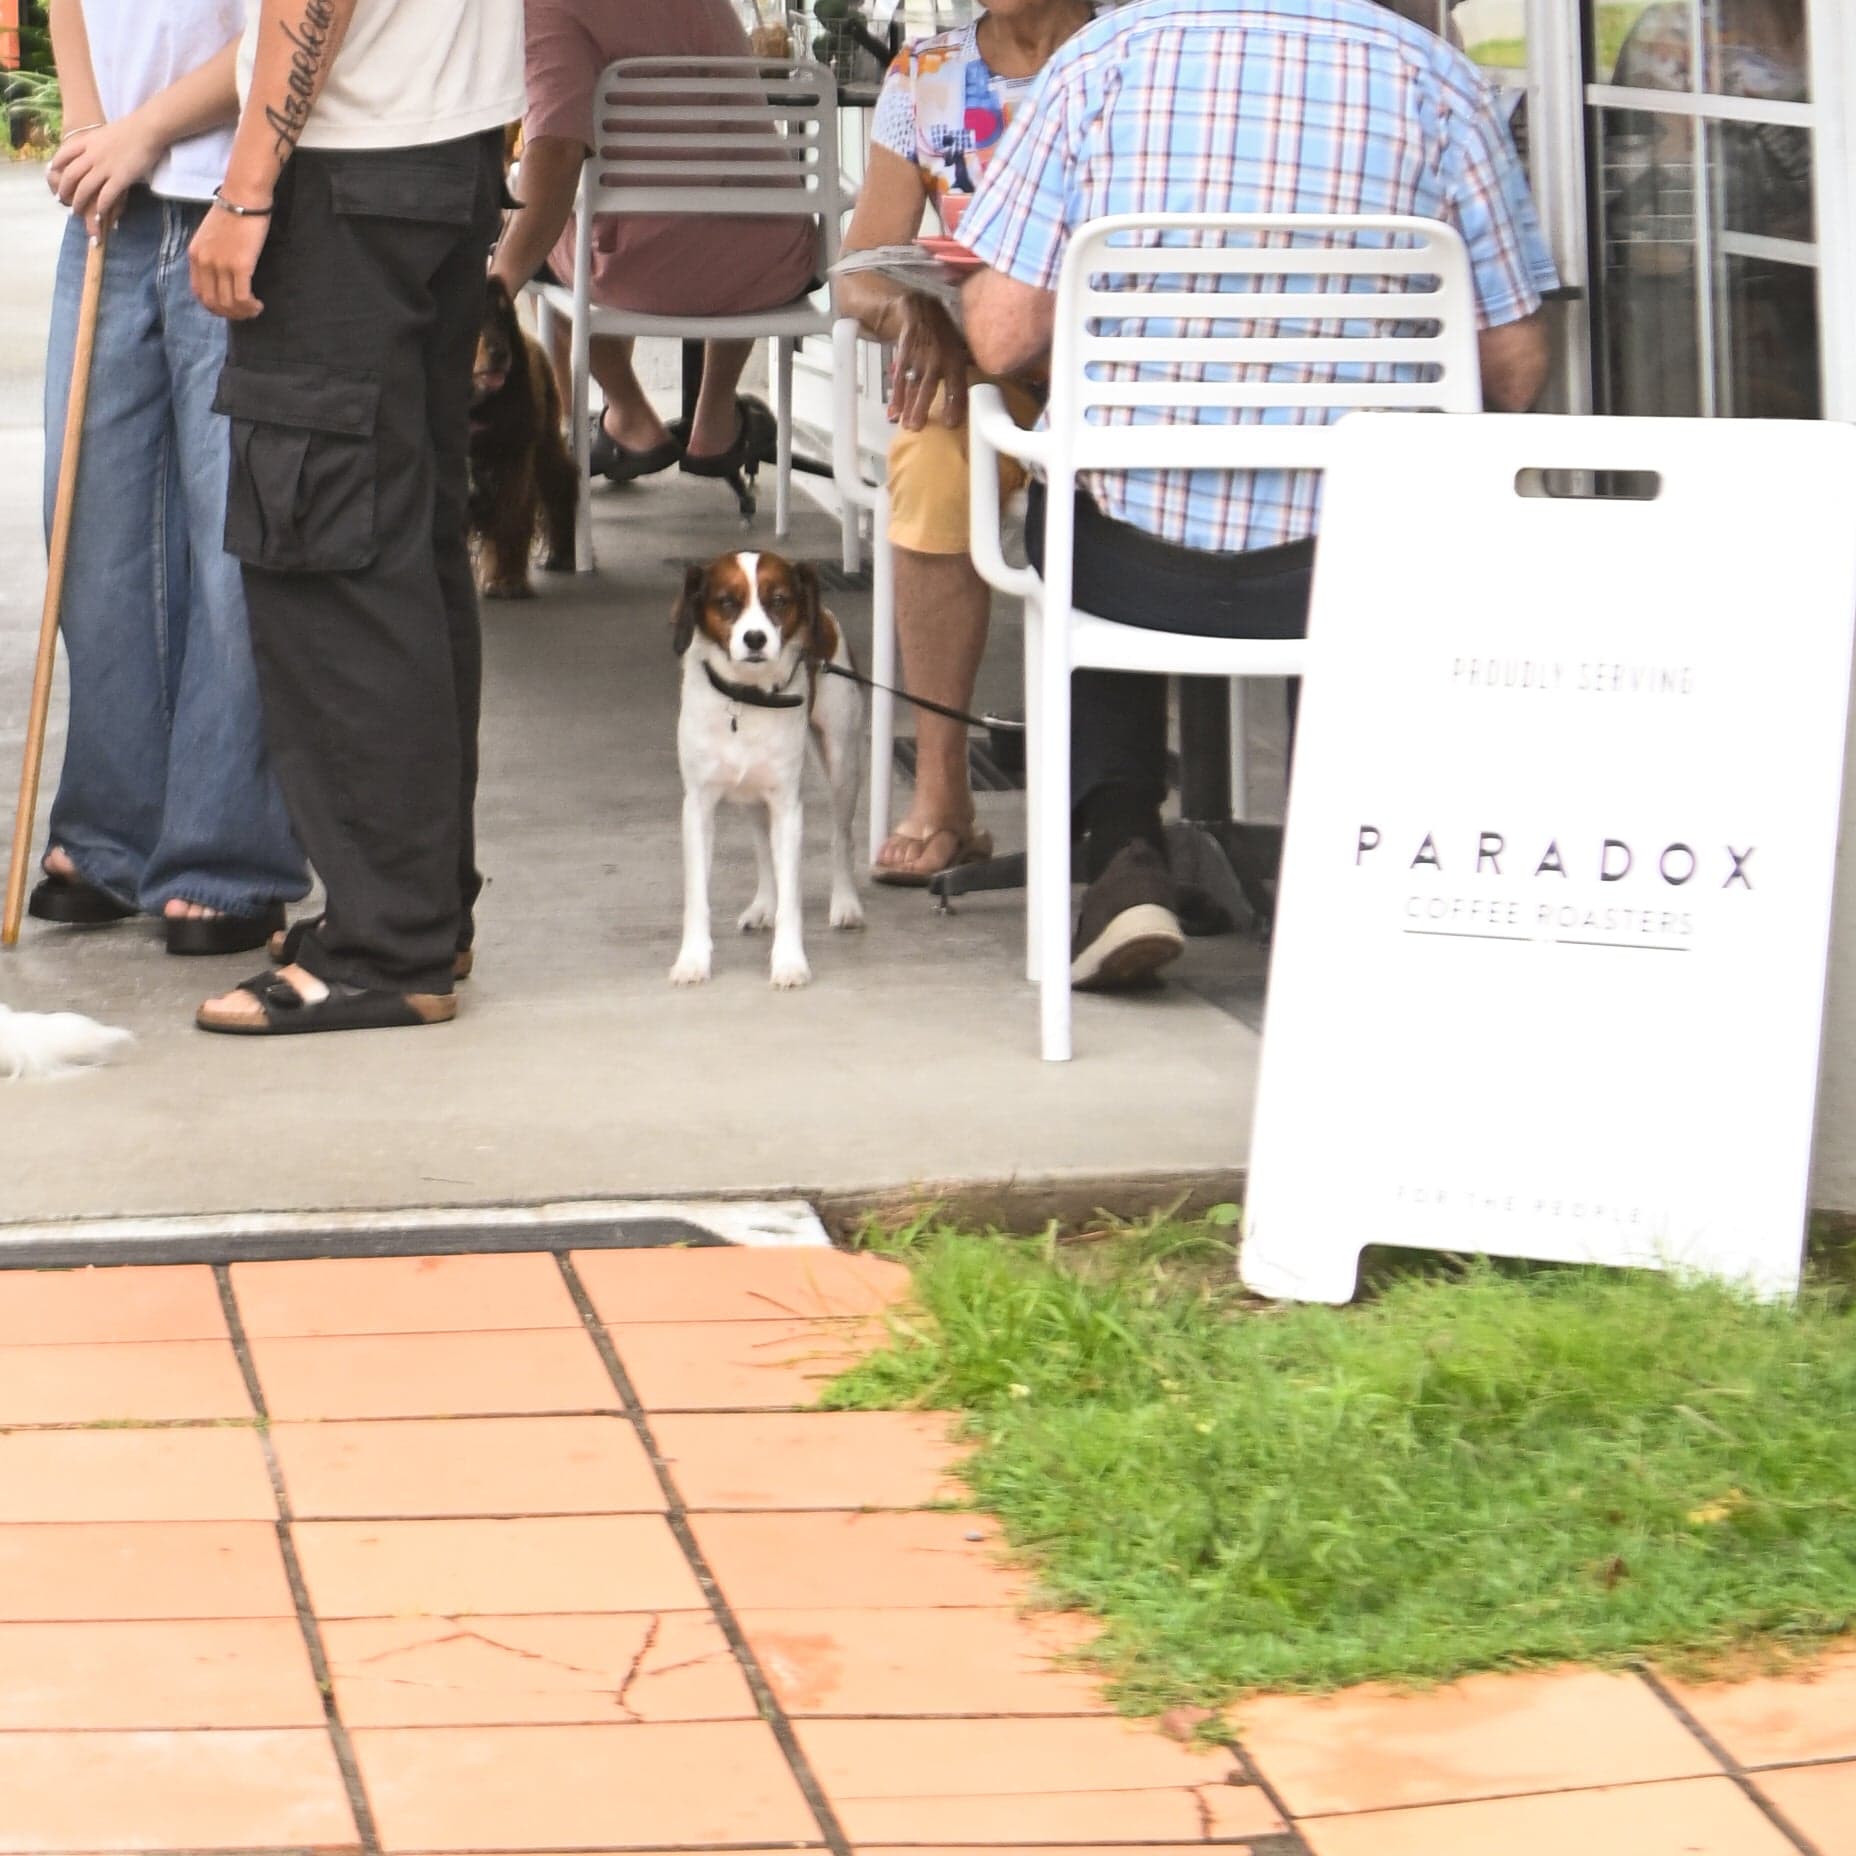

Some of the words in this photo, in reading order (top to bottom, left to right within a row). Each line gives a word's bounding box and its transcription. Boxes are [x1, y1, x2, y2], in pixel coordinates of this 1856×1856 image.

[1449, 656, 1565, 690] PROUDLY
[1576, 663, 1696, 696] SERVING
[1355, 824, 1756, 890] PARADOX
[1403, 895, 1520, 925] COFFEE
[1536, 902, 1696, 937] ROASTERS
